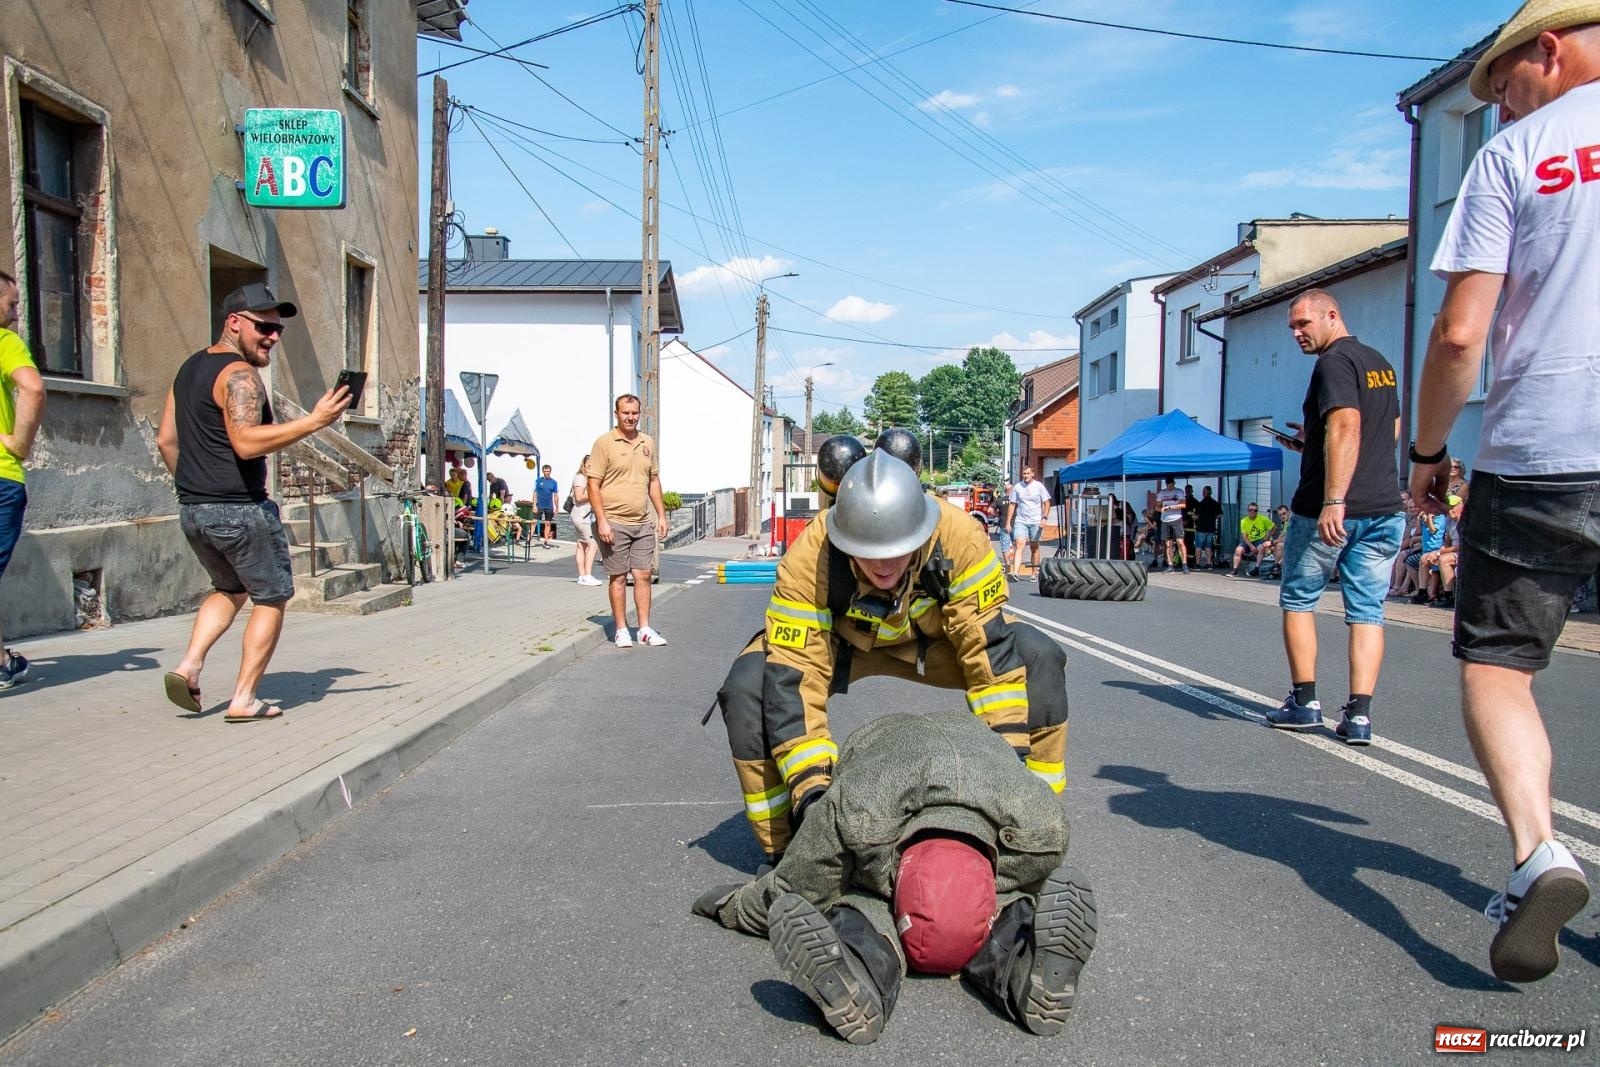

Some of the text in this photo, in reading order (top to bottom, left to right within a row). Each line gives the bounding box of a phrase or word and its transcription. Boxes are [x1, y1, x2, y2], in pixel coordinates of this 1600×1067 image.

[279, 120, 308, 130] SKLEP
[255, 156, 334, 197] ABC
[983, 580, 1002, 602] PSP
[775, 626, 801, 642] PSP
